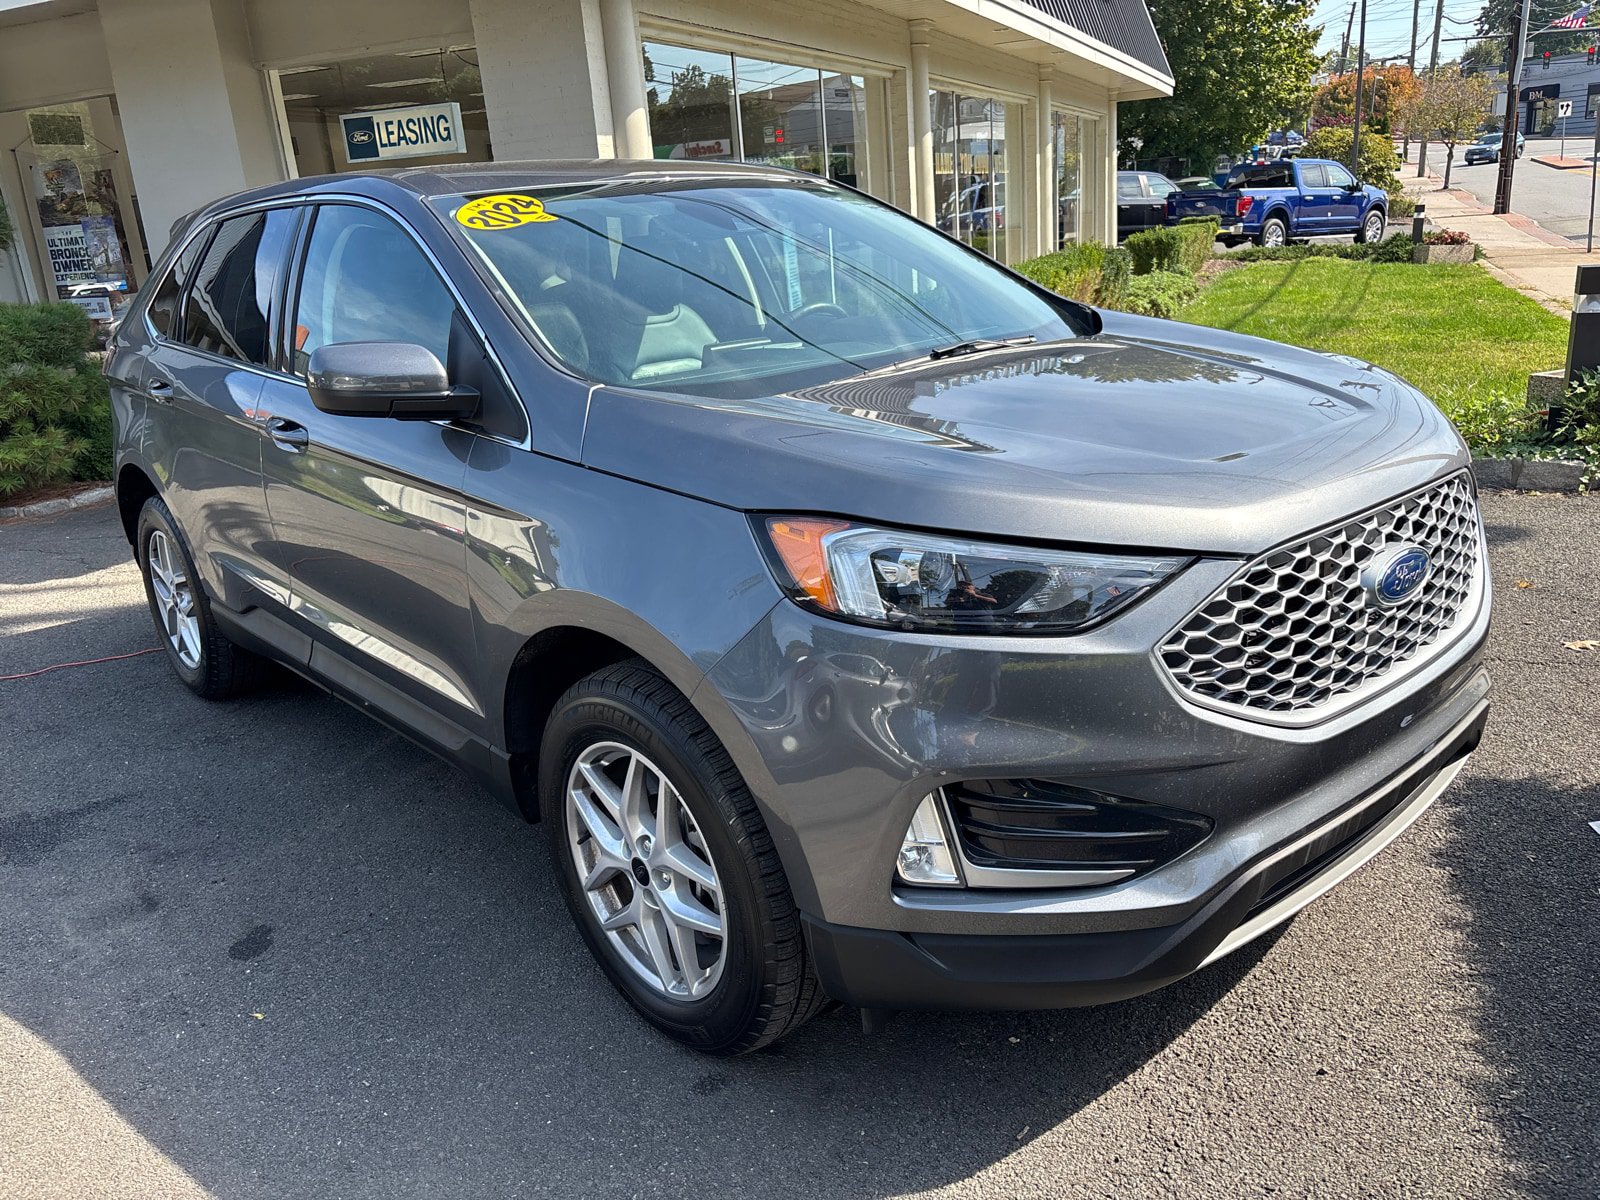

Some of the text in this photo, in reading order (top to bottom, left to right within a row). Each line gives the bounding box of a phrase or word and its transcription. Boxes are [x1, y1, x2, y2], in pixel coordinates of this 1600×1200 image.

[353, 114, 452, 148] Ford LEASING
[467, 197, 542, 228] 2024
[47, 235, 85, 248] ULTIMAT
[1392, 559, 1423, 590] Ford
[578, 704, 652, 739] MICHELIN
